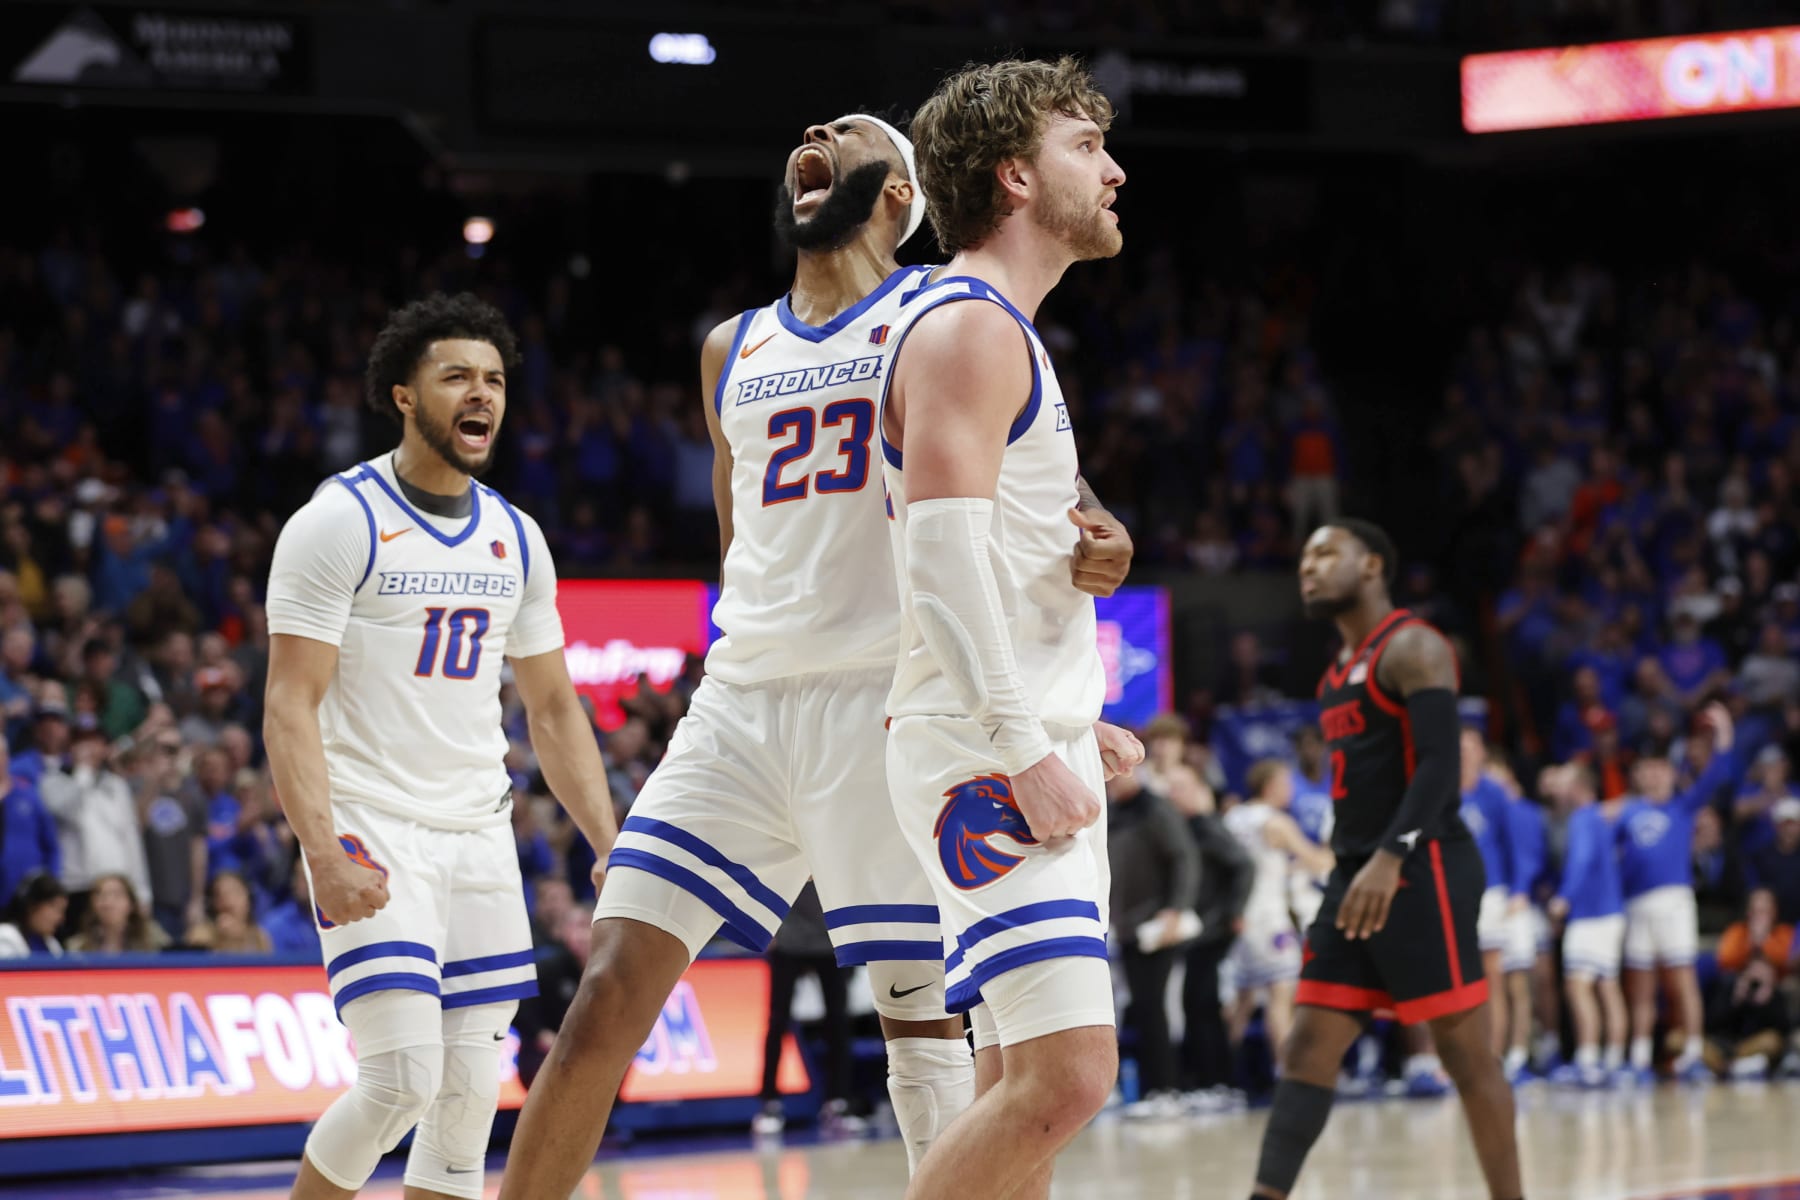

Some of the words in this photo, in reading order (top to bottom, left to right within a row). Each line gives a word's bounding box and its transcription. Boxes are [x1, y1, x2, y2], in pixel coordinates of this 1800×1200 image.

[1662, 36, 1776, 108] ON
[762, 397, 875, 508] 23
[378, 572, 516, 597] BRONCOS
[414, 607, 490, 680] 10
